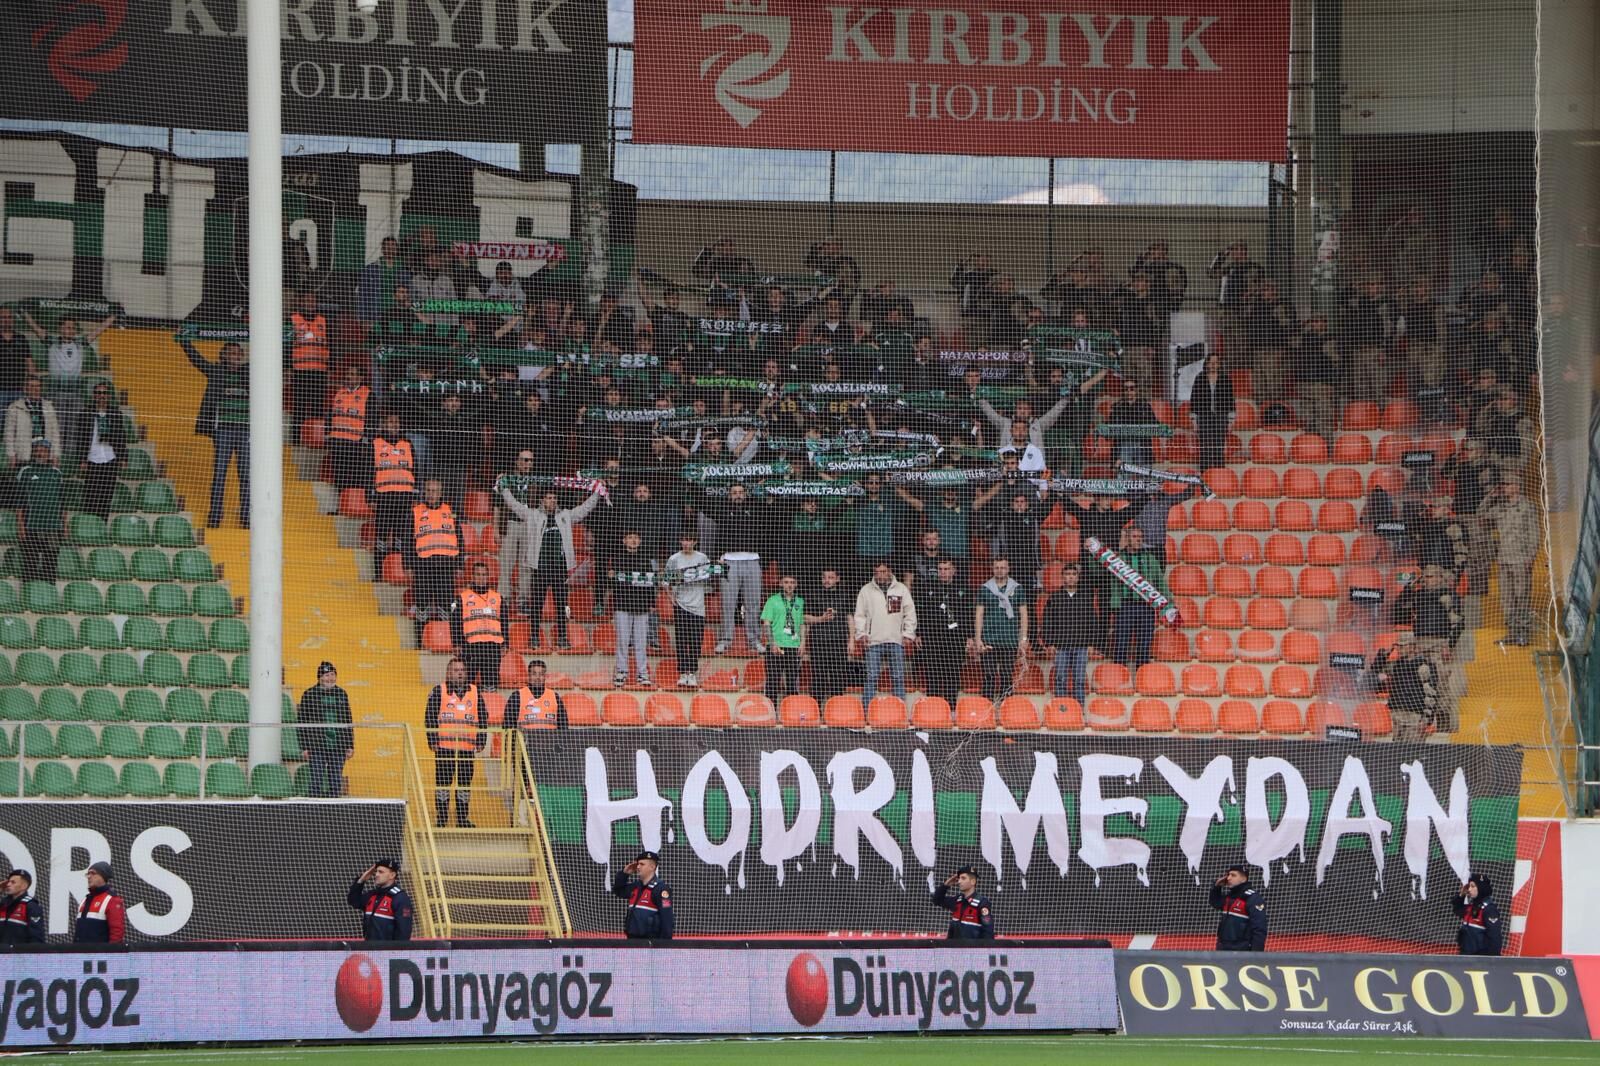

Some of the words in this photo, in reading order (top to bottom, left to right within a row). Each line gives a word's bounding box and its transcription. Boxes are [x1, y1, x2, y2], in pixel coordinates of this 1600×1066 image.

[824, 6, 1222, 71] KIRBIYIK
[281, 57, 489, 105] OLDİNG
[906, 79, 1139, 124] HOLDİNG
[940, 351, 1009, 361] HATAYSPOR
[1101, 548, 1168, 607] TURHALSPOR
[1351, 590, 1380, 599] JANDARMA
[1332, 656, 1362, 666] JANDARMA
[1329, 729, 1359, 738] JANDARMA
[980, 751, 1471, 901] MEYDAN
[390, 955, 612, 1035] Dünyagöz
[834, 955, 1036, 1030] Dünyagöz
[1129, 963, 1328, 1013] ORSE
[1354, 967, 1568, 1018] GOLD
[1279, 1018, 1324, 1030] Sonsuza
[1326, 1019, 1360, 1031] Kadar
[1362, 1020, 1390, 1031] Sürer
[1392, 1021, 1418, 1033] Aşk
